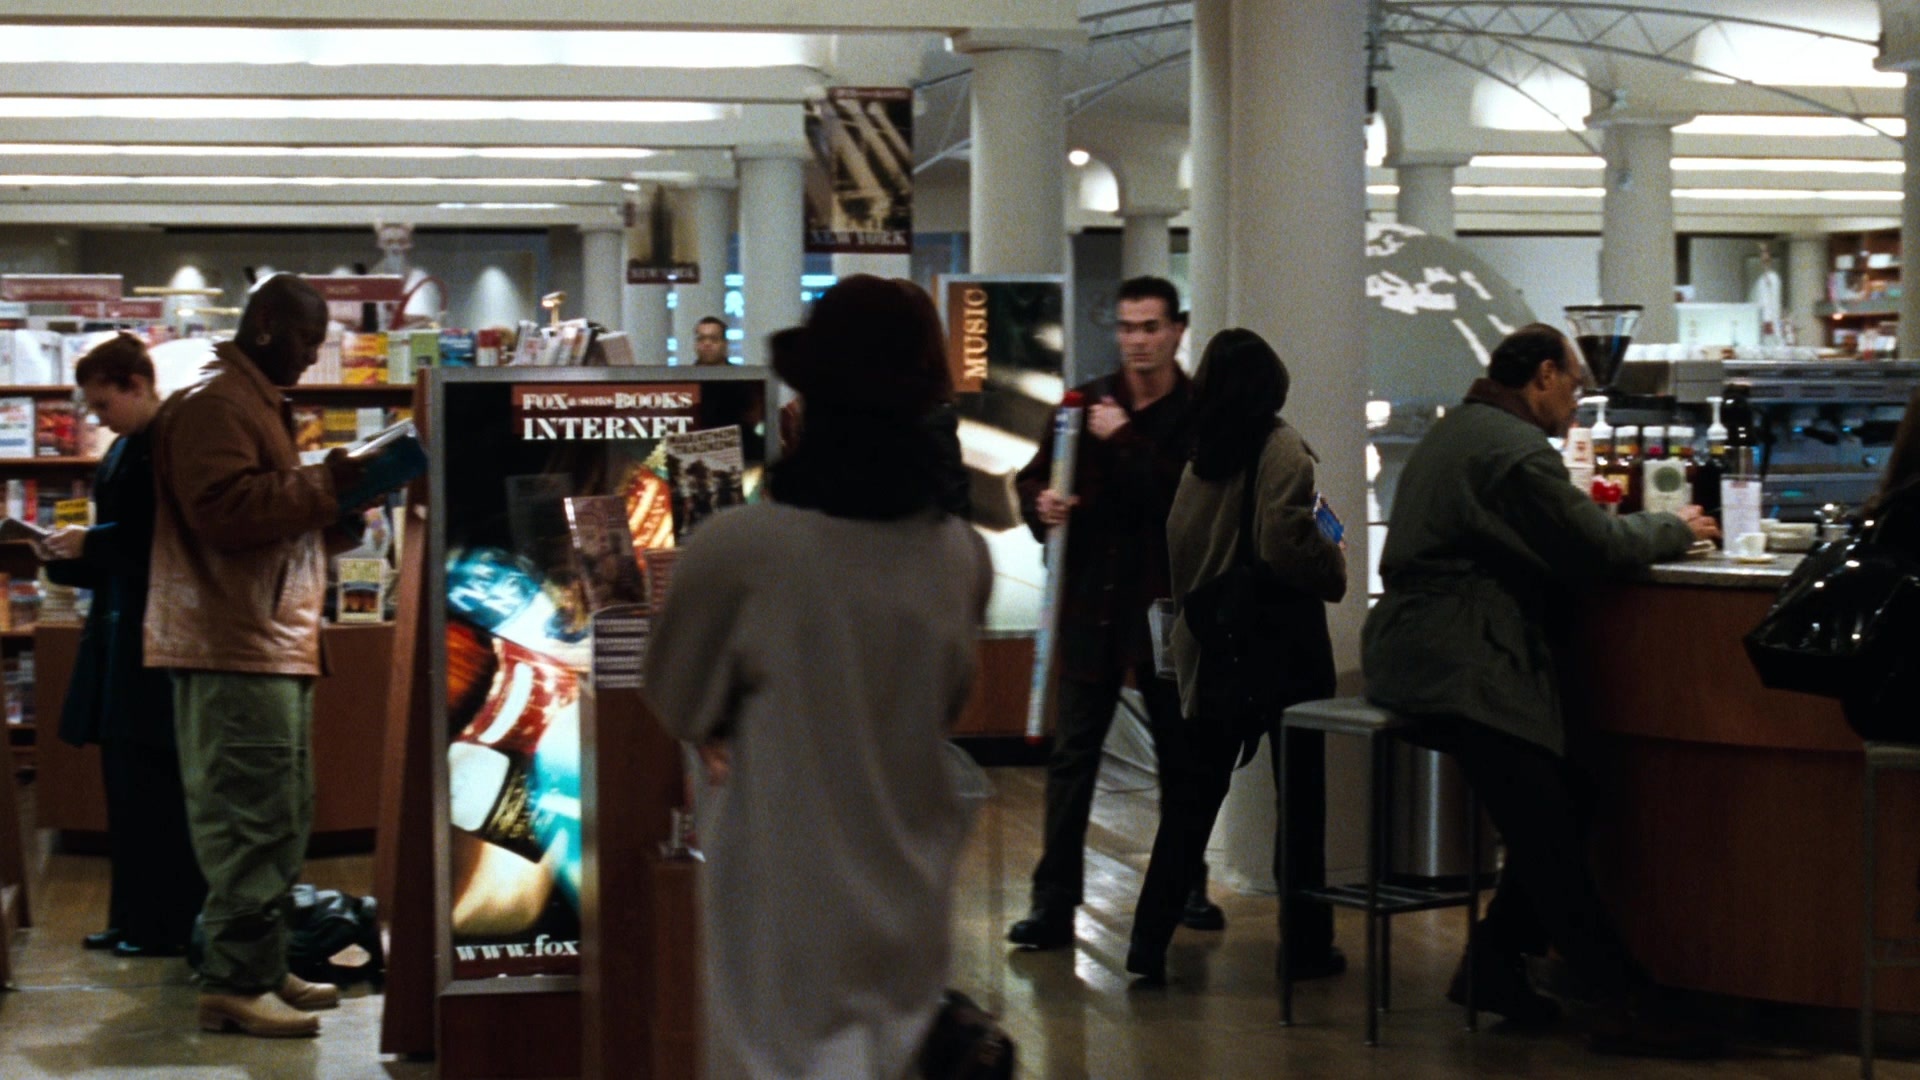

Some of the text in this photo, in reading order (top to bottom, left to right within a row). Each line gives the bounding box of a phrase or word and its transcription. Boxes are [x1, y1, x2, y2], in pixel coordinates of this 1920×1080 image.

[963, 288, 988, 379] MUSIC
[522, 392, 569, 410] FOX
[614, 391, 693, 409] BOOKS
[523, 416, 694, 440] INTERNET
[456, 934, 580, 961] www.fox
